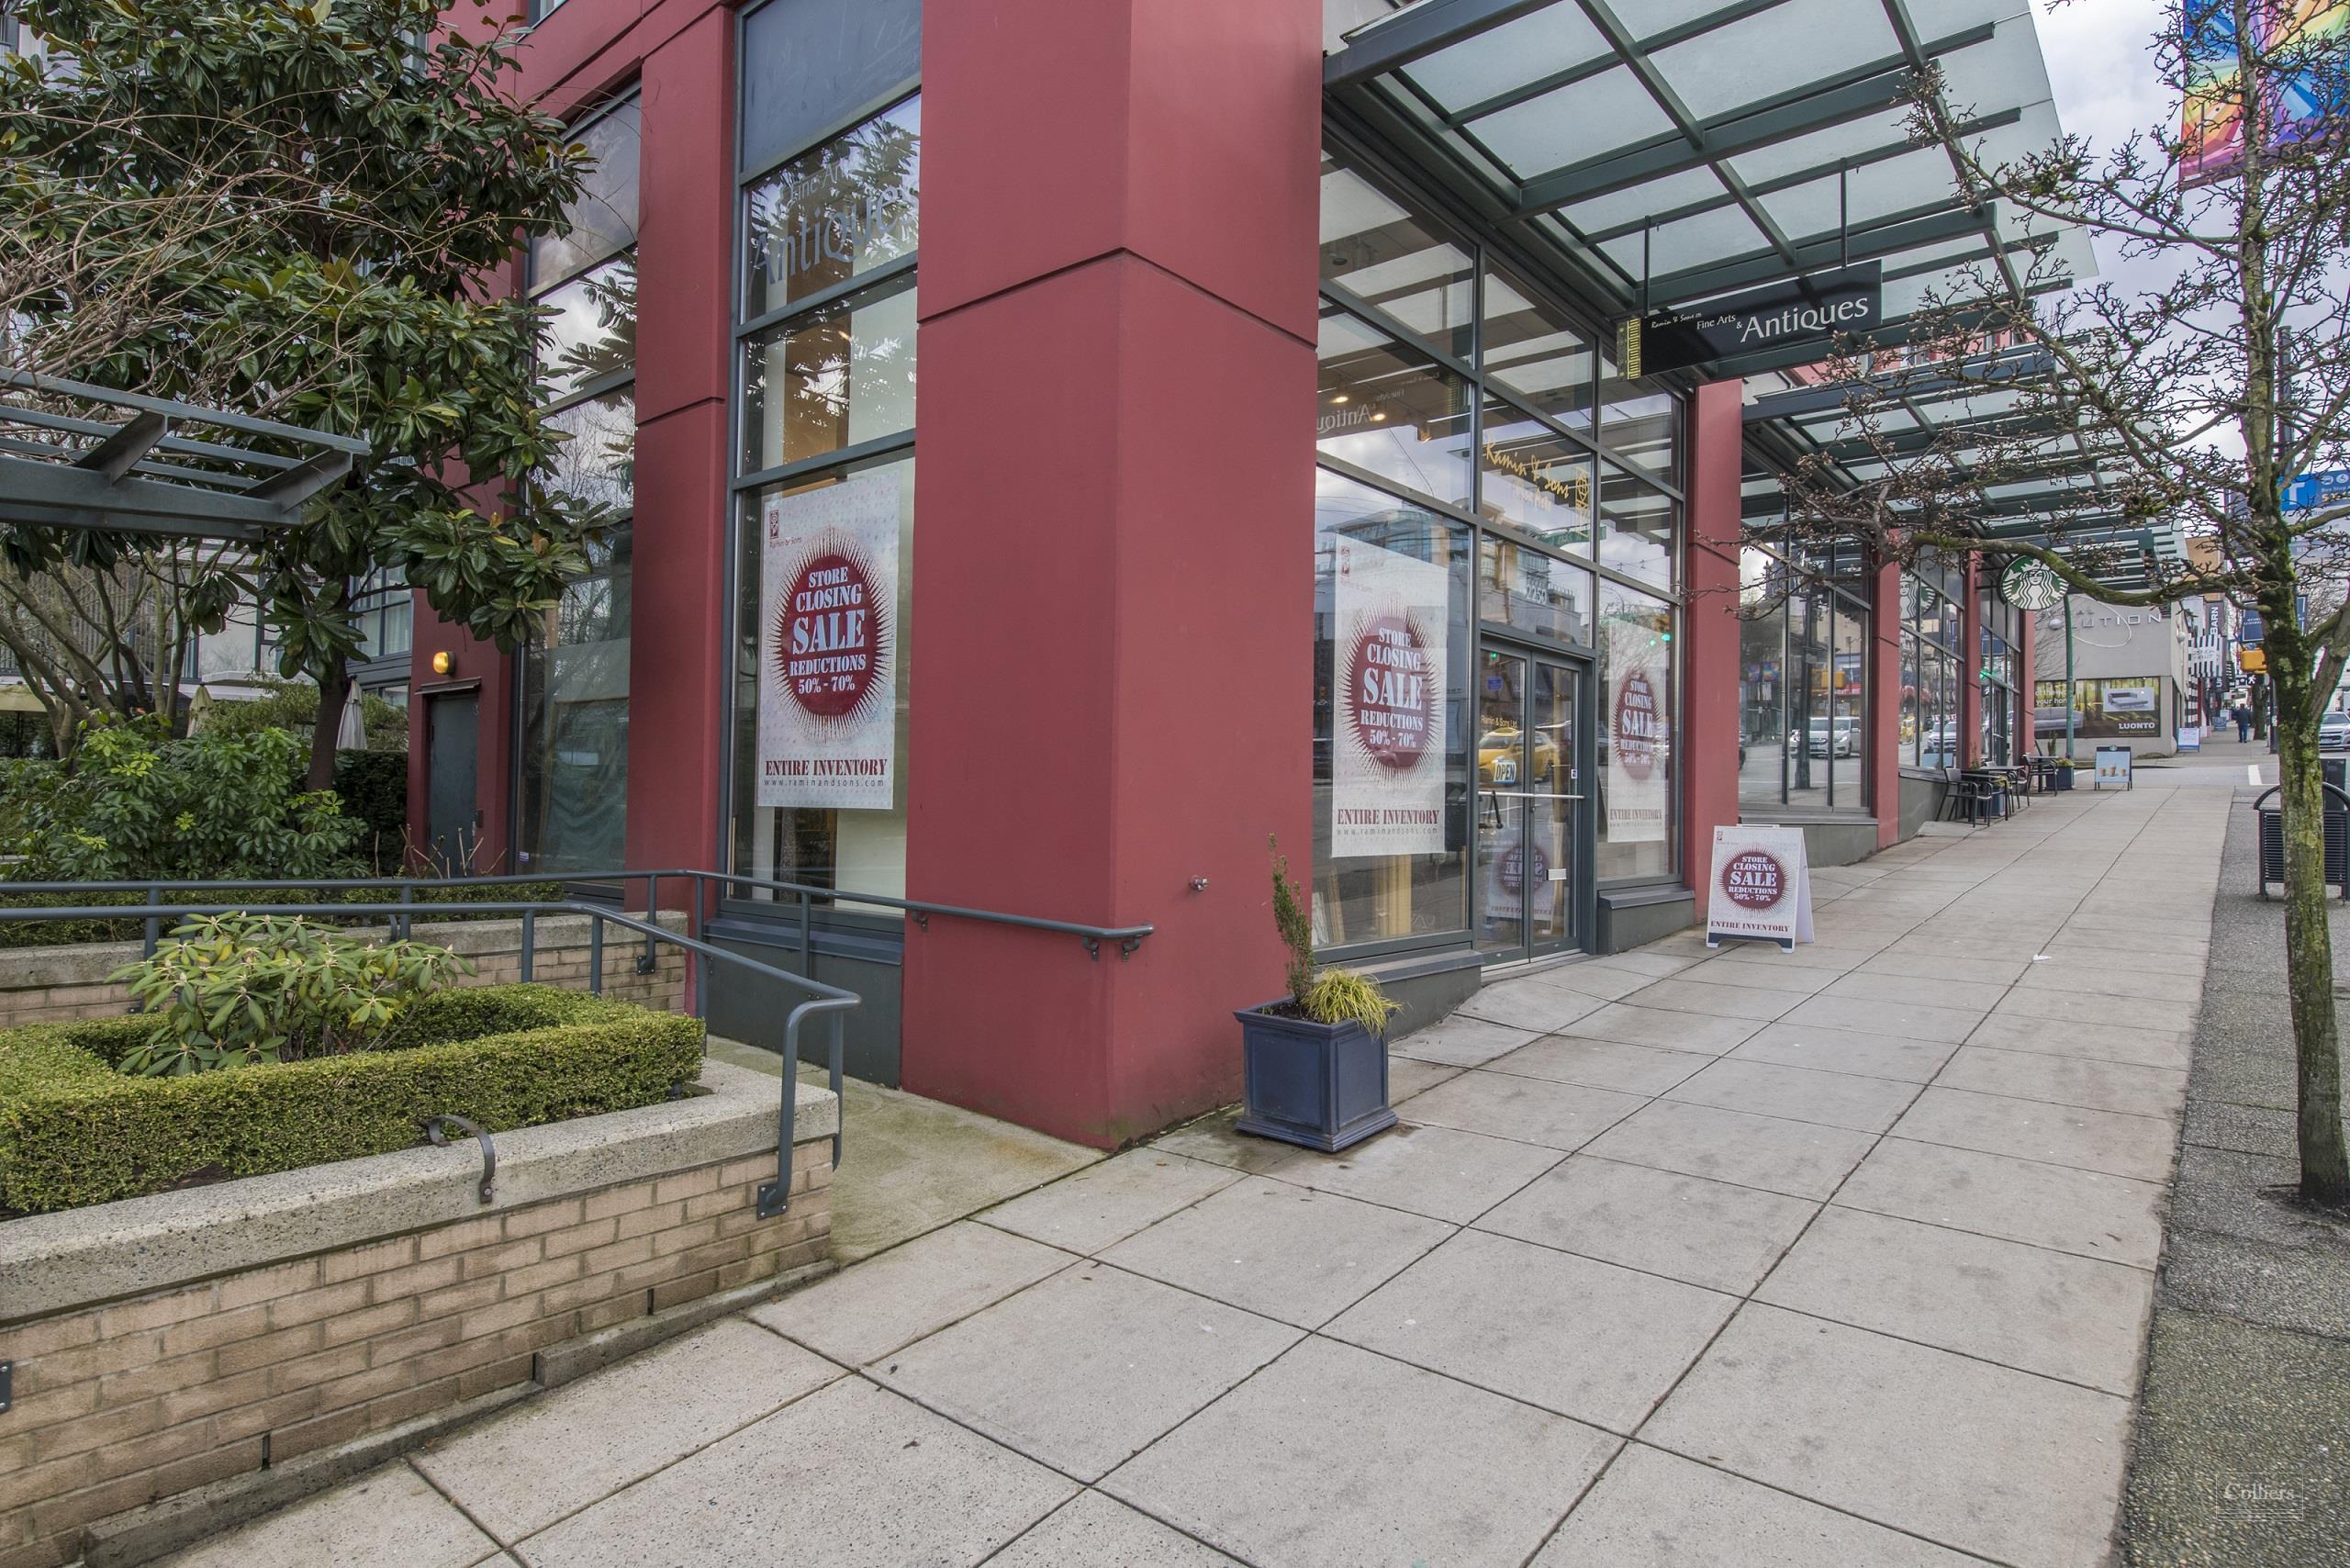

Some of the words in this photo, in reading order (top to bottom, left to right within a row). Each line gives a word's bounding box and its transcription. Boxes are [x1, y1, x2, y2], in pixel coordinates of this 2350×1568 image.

[1696, 319, 1716, 330] Fine
[1717, 314, 1737, 326] Arts
[1736, 321, 1743, 330] &
[1740, 297, 1869, 343] Antiques
[808, 566, 848, 588] STORE
[795, 583, 862, 613] CLOSING
[2210, 607, 2219, 635] BARN
[792, 609, 865, 655] SALE
[1379, 627, 1412, 648] STORE
[789, 654, 867, 677] REDUCTIONS
[1367, 643, 1421, 672] CLOSING
[798, 677, 822, 695] 50%
[831, 675, 856, 692] 70%
[1363, 666, 1423, 711] SALE
[1625, 691, 1652, 710] CLOSING
[1360, 709, 1424, 732] REDUCTIONS
[1622, 709, 1653, 737] SALE
[1369, 729, 1391, 745] 50%
[1398, 732, 1416, 748] 70%
[765, 760, 810, 776] ENTIRE
[812, 758, 888, 776] INVENTORY
[1496, 763, 1516, 780] OPEN
[764, 778, 884, 787] www.raminandsons.com
[1337, 809, 1380, 825] ENTIRE
[1382, 809, 1439, 825] INVENTORY
[1733, 863, 1775, 871] CLOSING
[1730, 871, 1777, 887] SALE
[1729, 887, 1778, 895] REDUCTIONS
[1711, 921, 1740, 929] ENTIRE
[1742, 924, 1790, 932] INVENTORY
